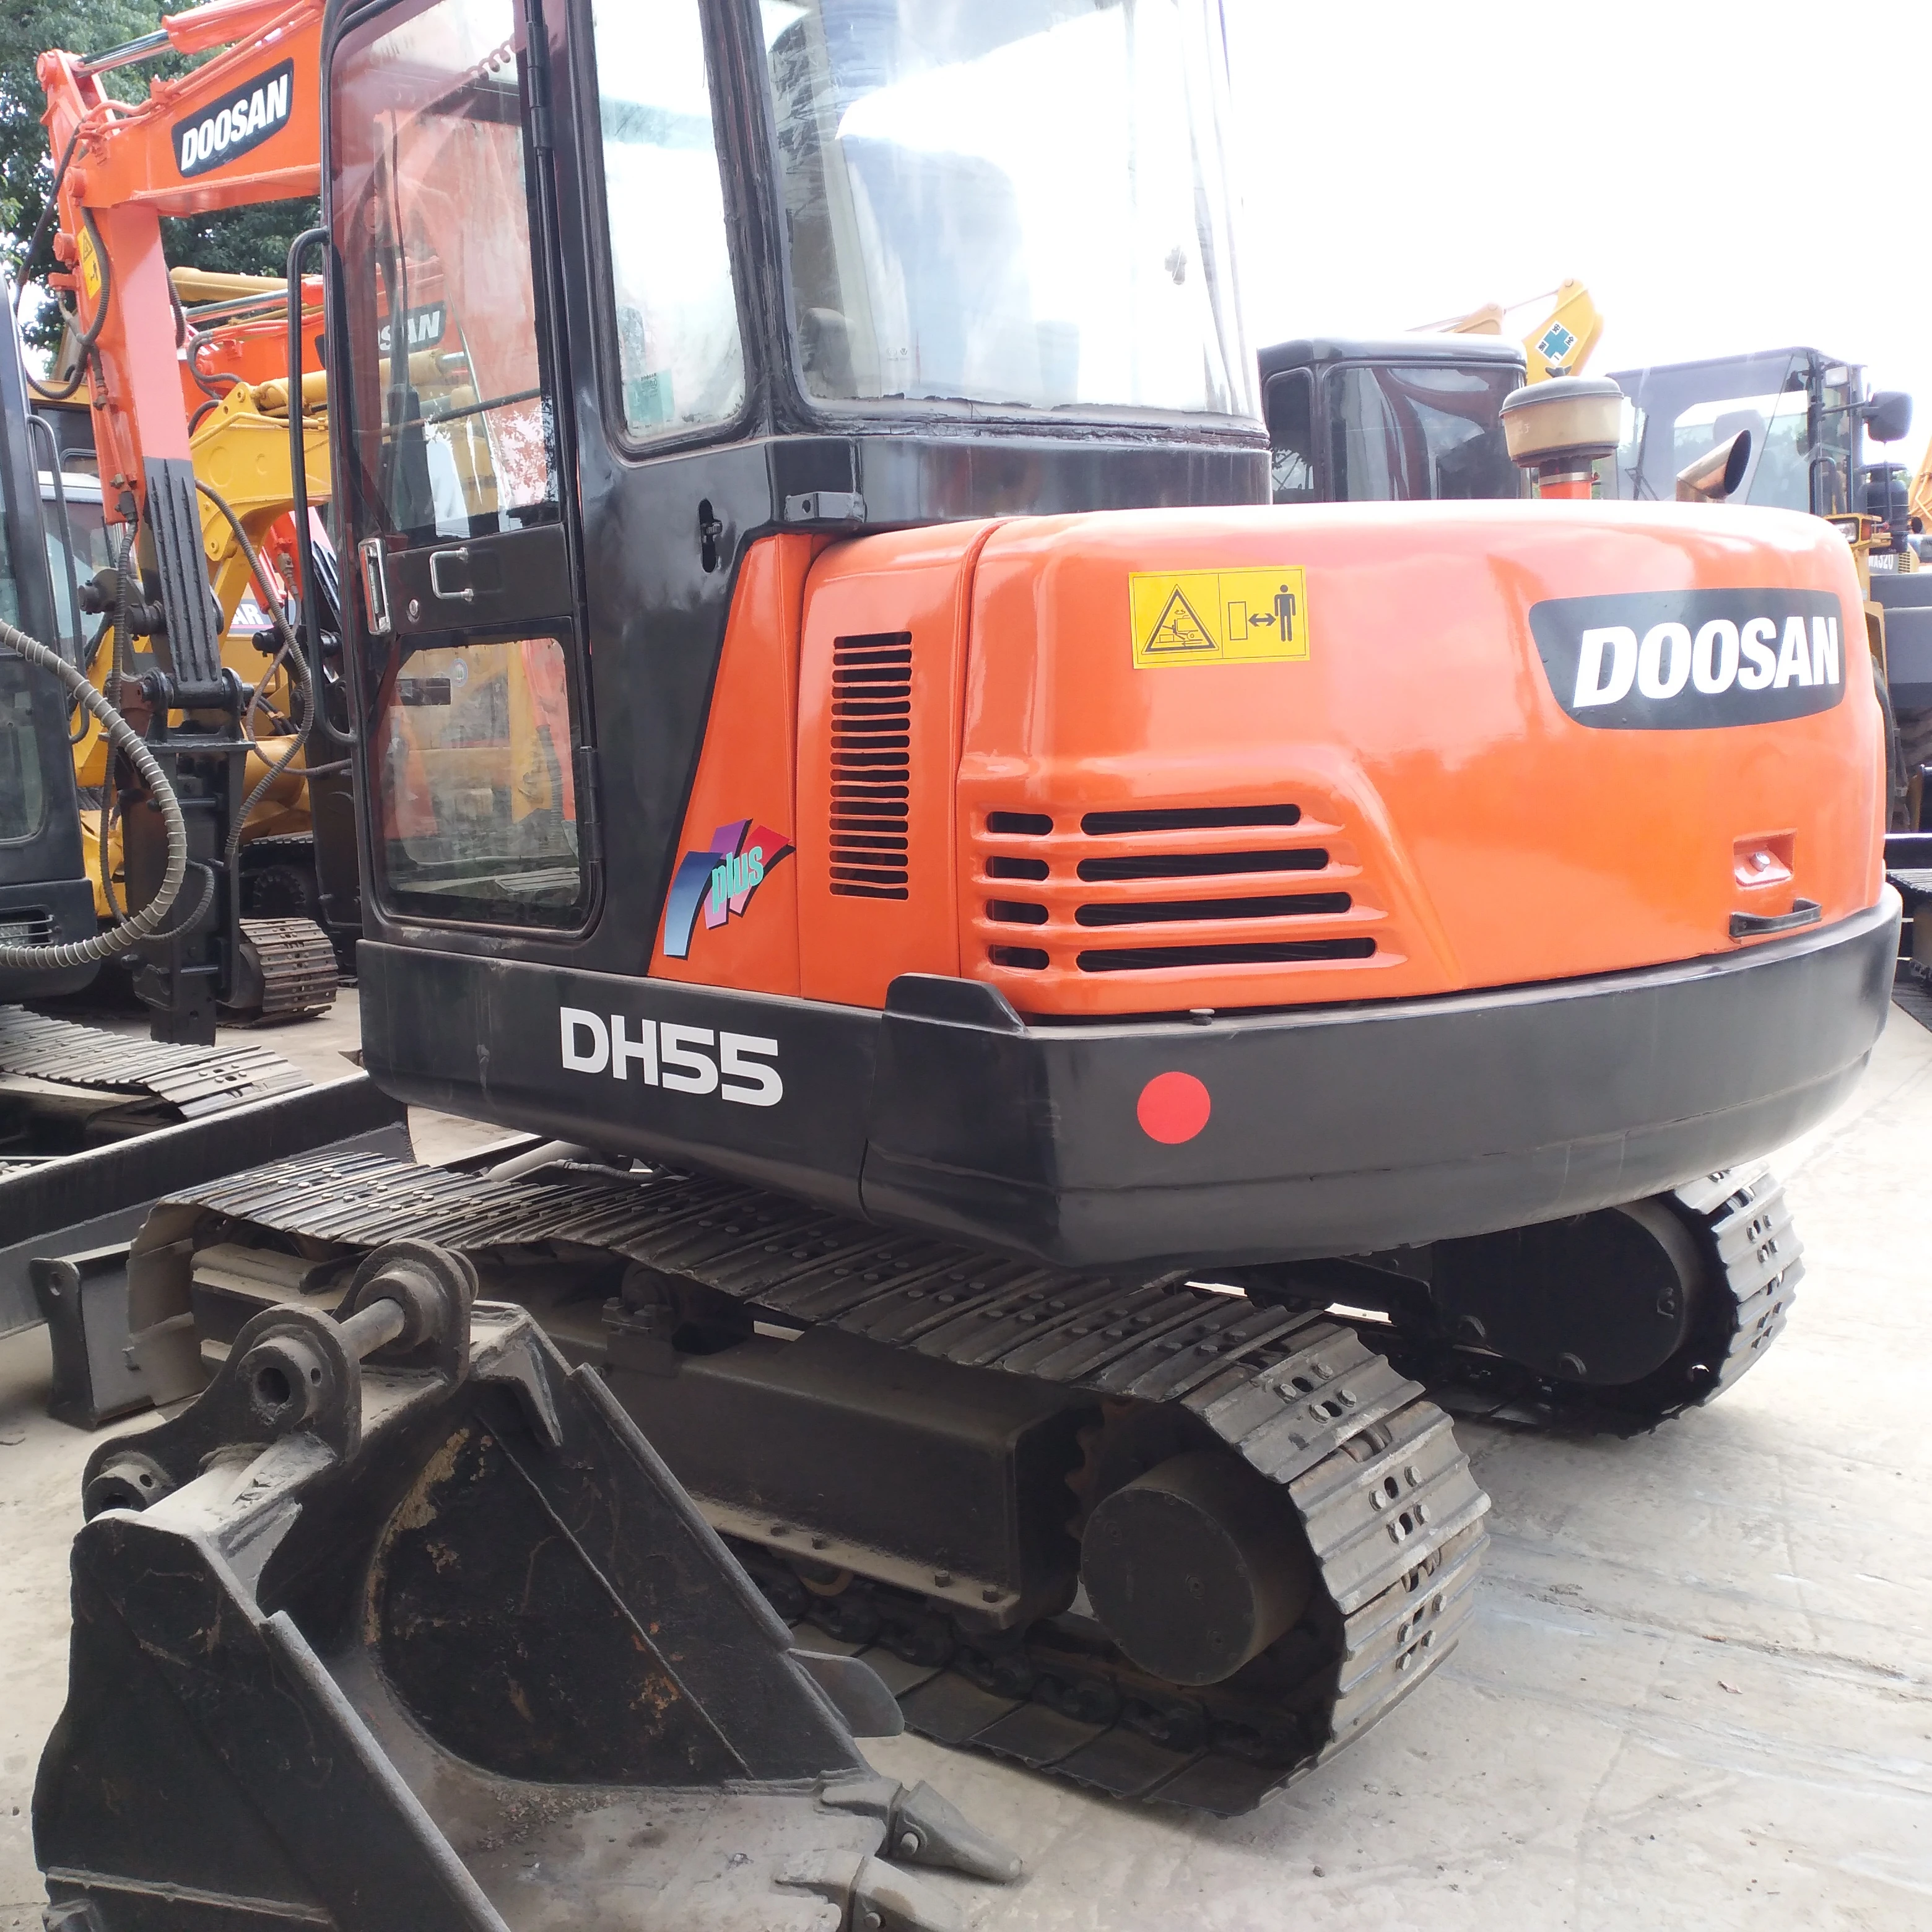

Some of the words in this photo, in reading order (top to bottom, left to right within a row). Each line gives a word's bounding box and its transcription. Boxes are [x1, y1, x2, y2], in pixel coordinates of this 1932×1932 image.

[181, 73, 288, 165] DOOSAN
[1573, 616, 1840, 708] DOOSAN
[711, 846, 764, 914] plus
[560, 1006, 783, 1107] DH55
